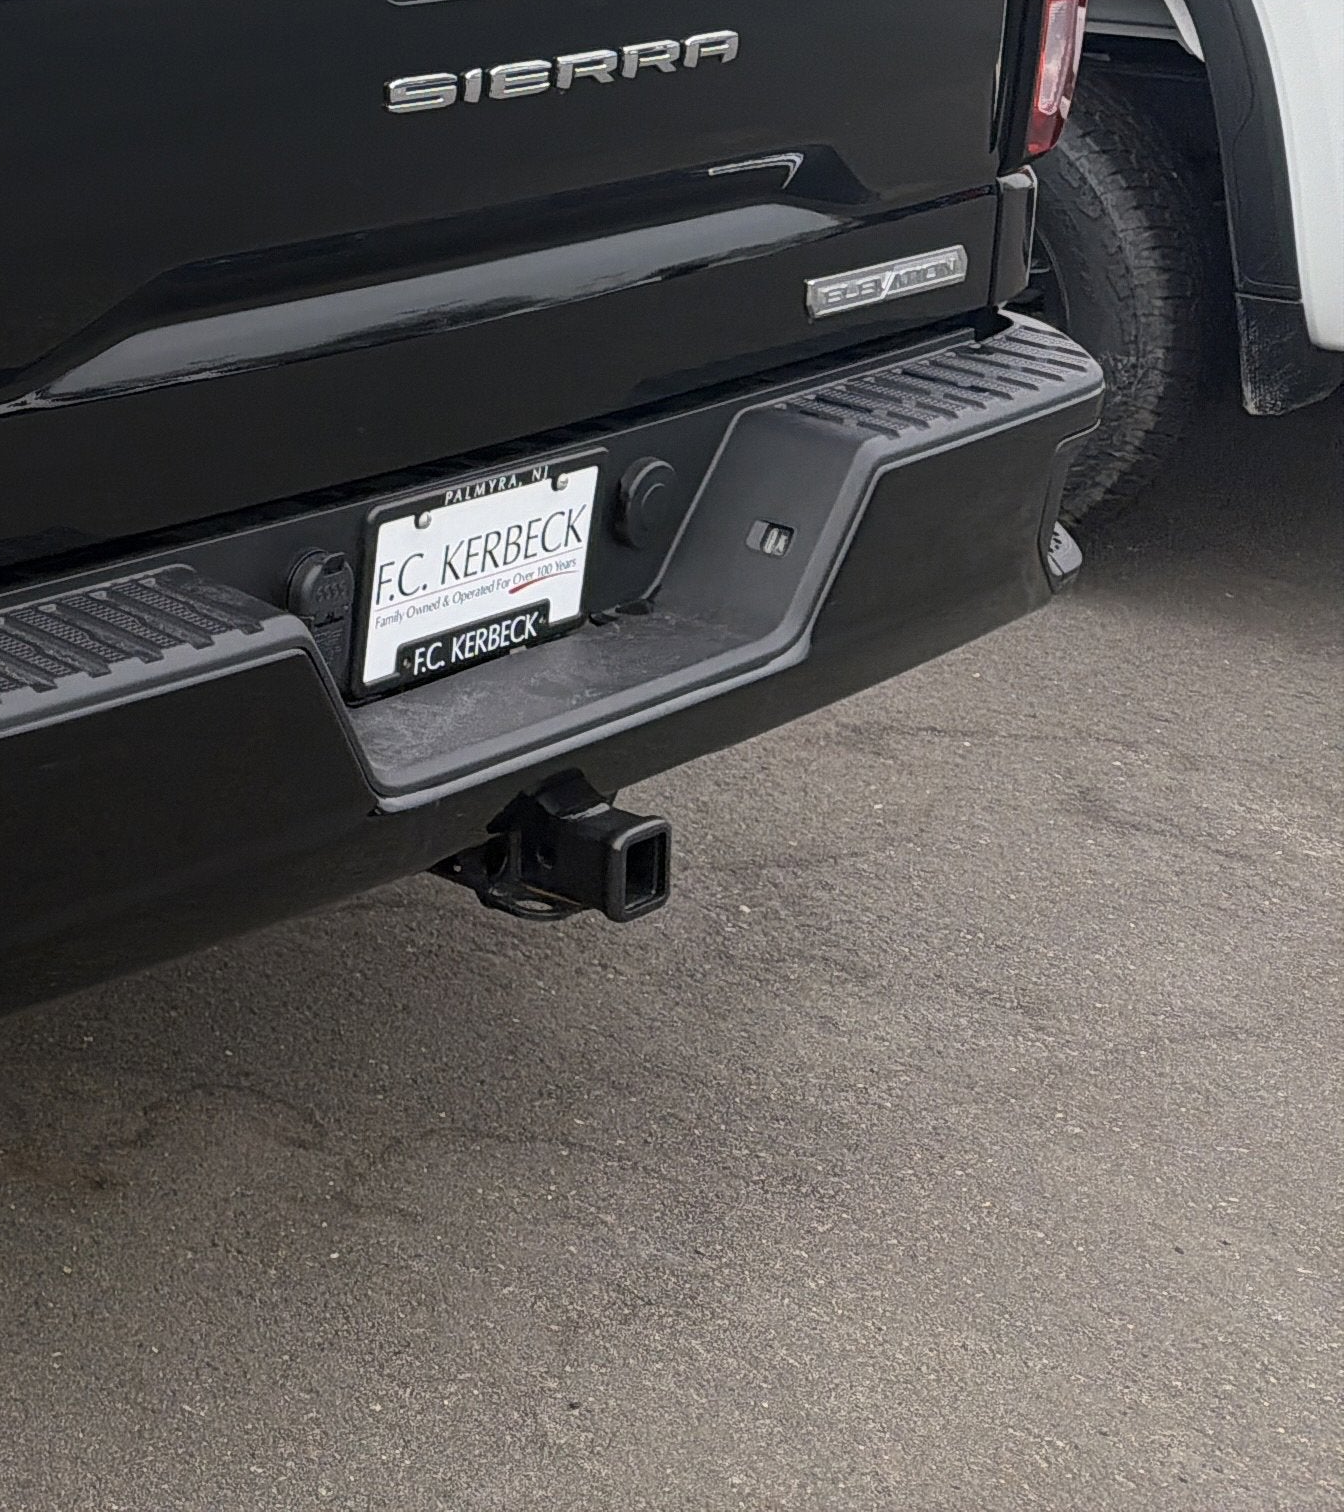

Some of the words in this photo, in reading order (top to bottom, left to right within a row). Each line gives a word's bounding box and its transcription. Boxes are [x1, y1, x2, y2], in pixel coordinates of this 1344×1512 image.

[383, 29, 740, 113] SIERRA
[444, 473, 523, 506] PALMYRA,
[375, 552, 428, 606] F.C.
[440, 504, 587, 585] KERBECK
[375, 609, 405, 629] Family
[406, 596, 442, 619] Owned
[442, 595, 450, 608] &
[452, 577, 496, 606] Operated
[496, 578, 511, 591] For
[512, 571, 535, 585] Over
[537, 563, 553, 577] 100
[554, 558, 577, 572] Years
[413, 641, 446, 676] F.C.
[451, 611, 539, 663] KERBECK
